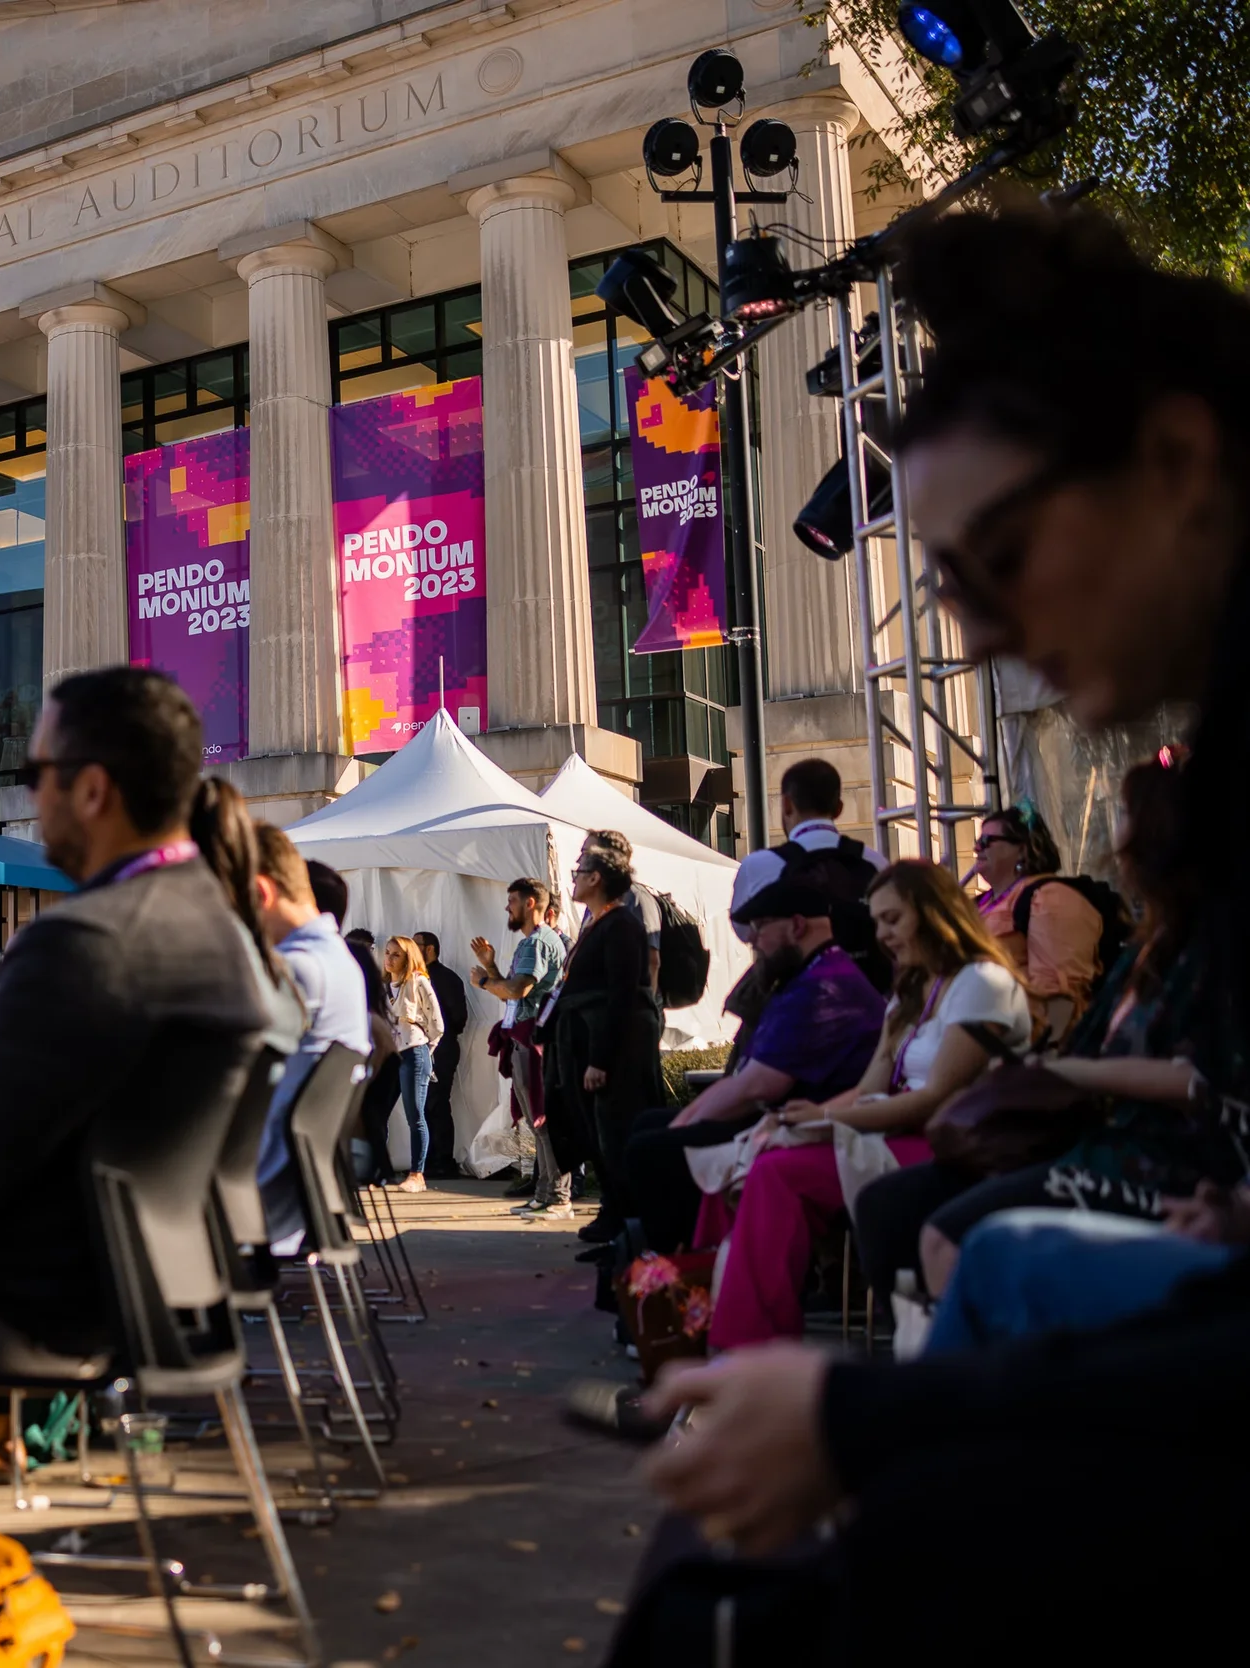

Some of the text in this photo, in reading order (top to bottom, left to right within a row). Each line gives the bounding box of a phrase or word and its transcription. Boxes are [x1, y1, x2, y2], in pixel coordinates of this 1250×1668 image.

[72, 72, 448, 226] AUDITORIUM
[640, 474, 698, 503] PENDO
[642, 486, 717, 519] MONIUM
[679, 502, 718, 526] 2023
[344, 519, 448, 557] PENDO
[138, 559, 225, 596] PENDO
[344, 539, 474, 583] MONIUM
[138, 578, 250, 620] MONIUM
[403, 566, 476, 602] 2023
[187, 603, 250, 636] 2023
[202, 743, 222, 755] ndo
